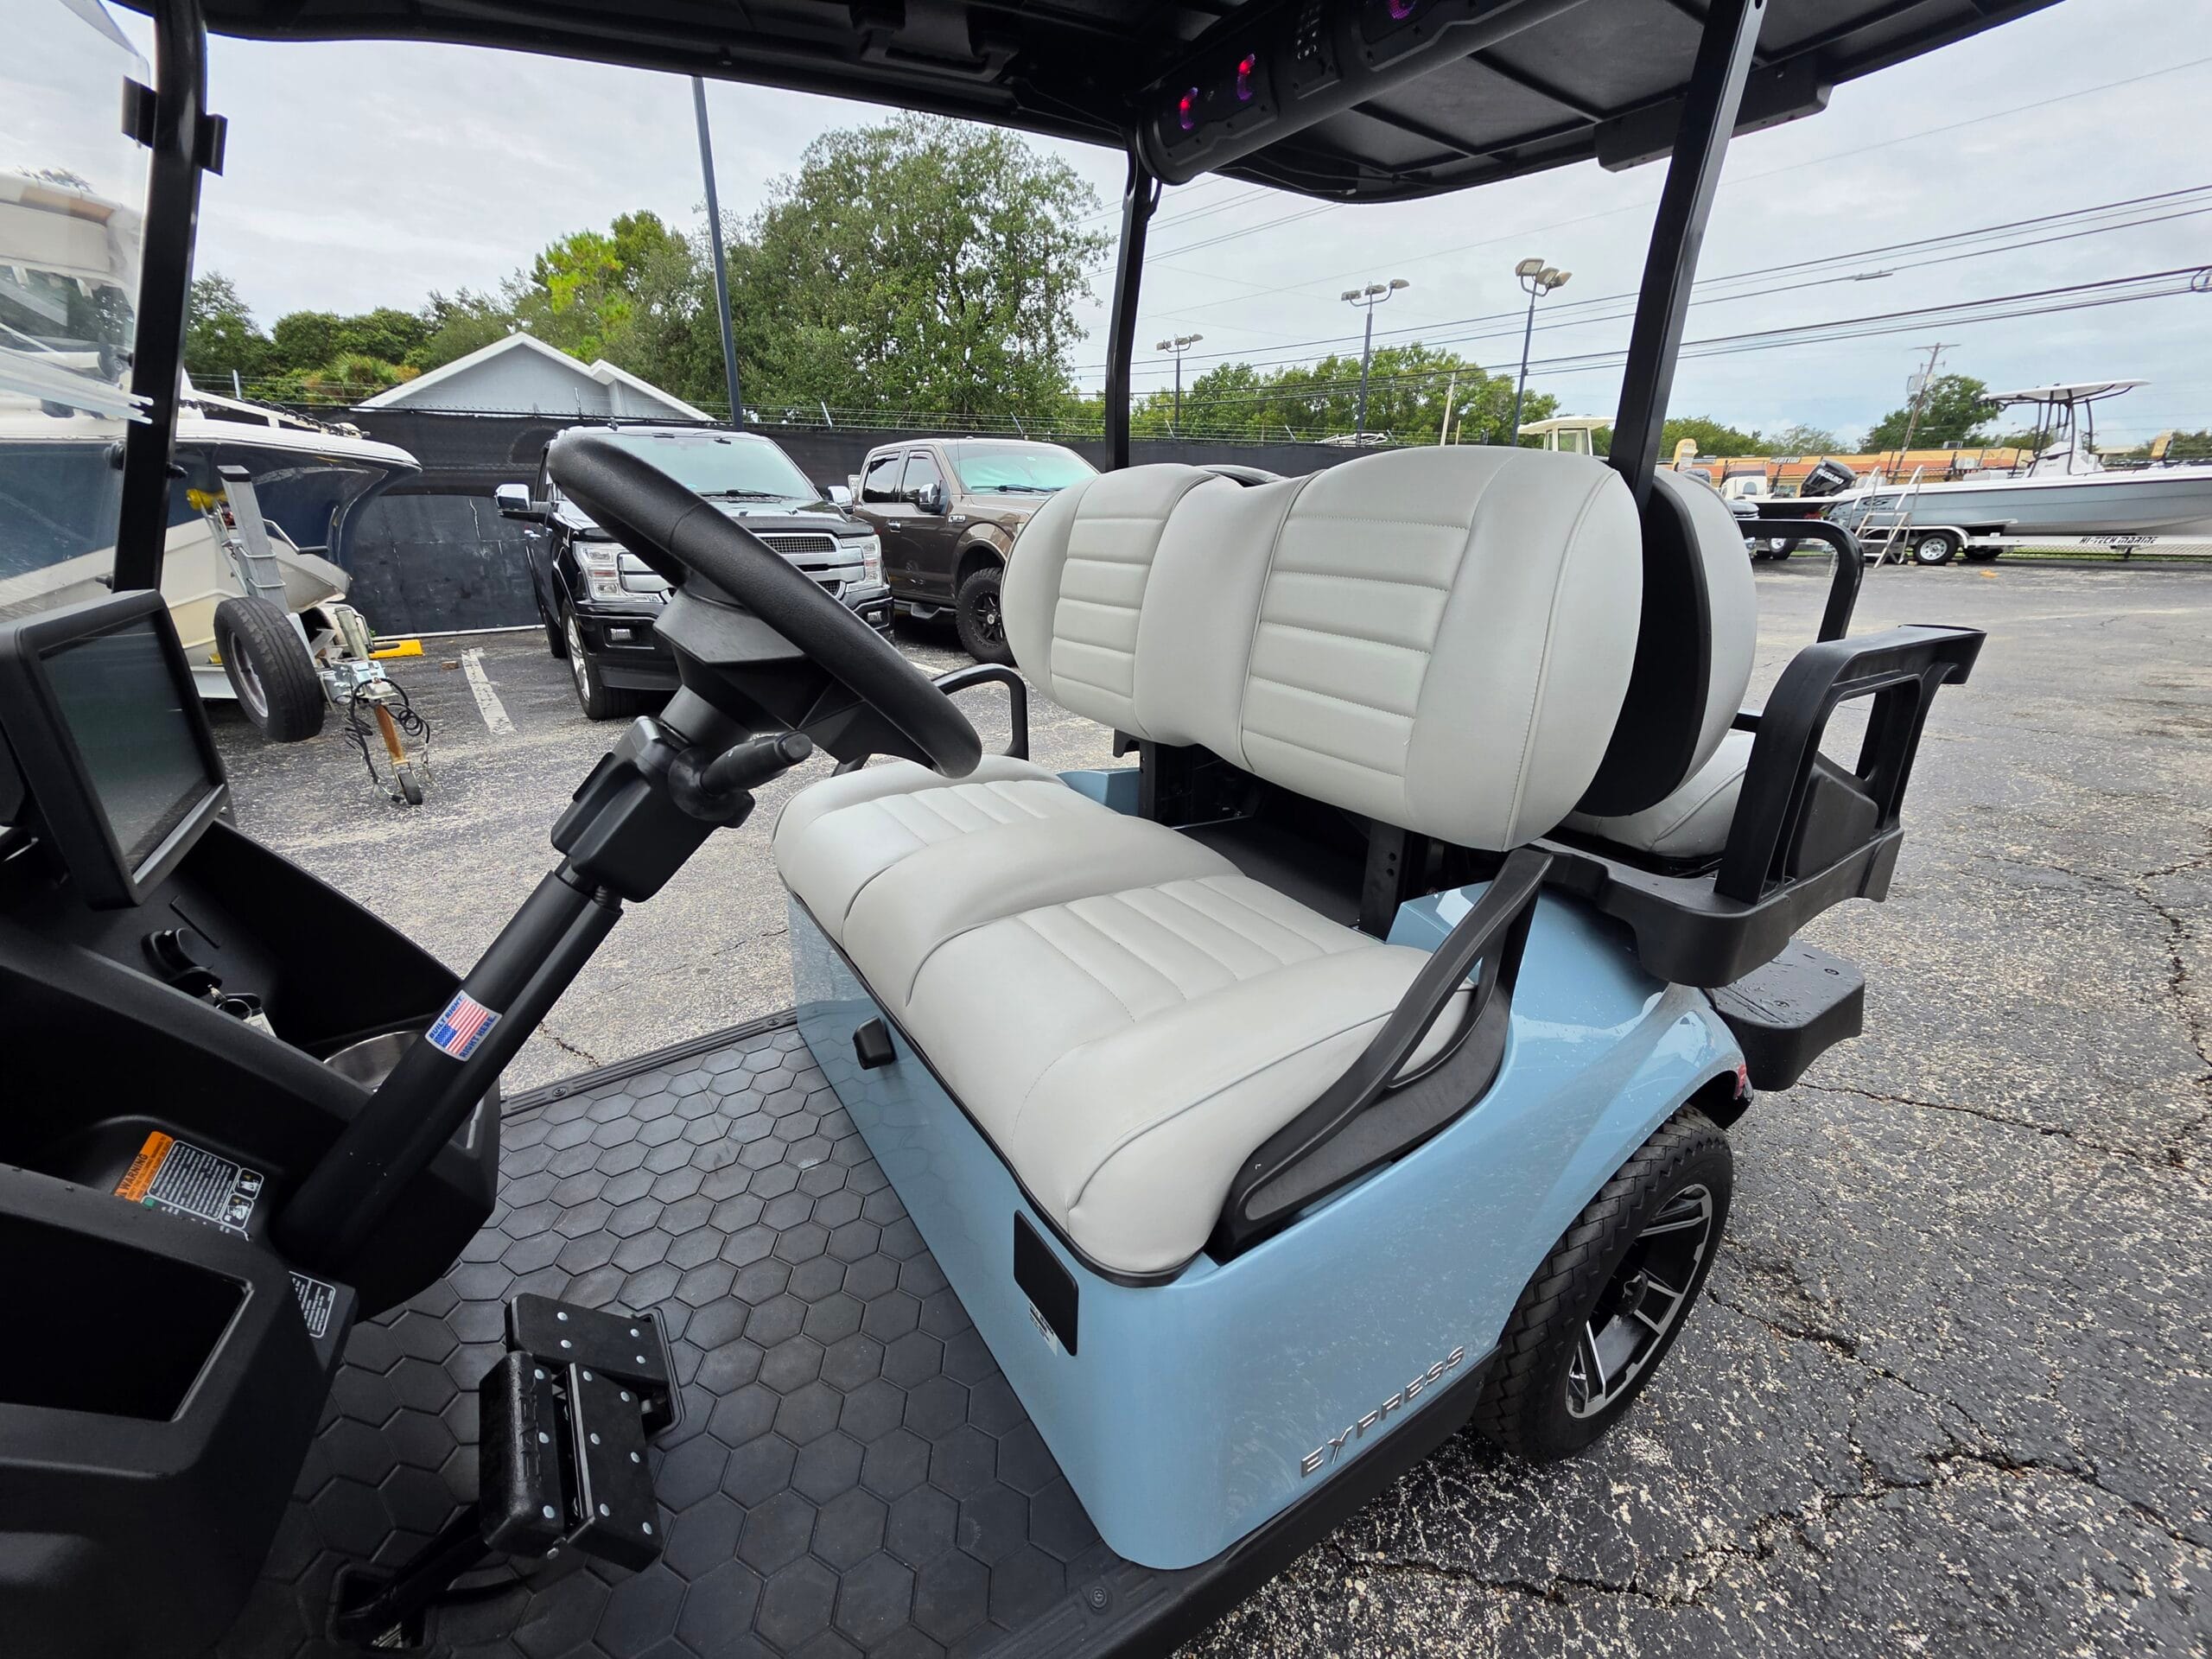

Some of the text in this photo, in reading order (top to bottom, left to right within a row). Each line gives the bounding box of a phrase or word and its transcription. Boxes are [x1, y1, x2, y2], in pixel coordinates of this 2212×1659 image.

[1816, 467, 1845, 485] SUZUKI
[2079, 536, 2118, 544] HI-TECH
[429, 1019, 446, 1039] BUILT
[459, 1015, 497, 1058] RIGHT HERE.
[120, 1154, 149, 1190] WARNING
[1300, 1345, 1465, 1478] EXPRESS
